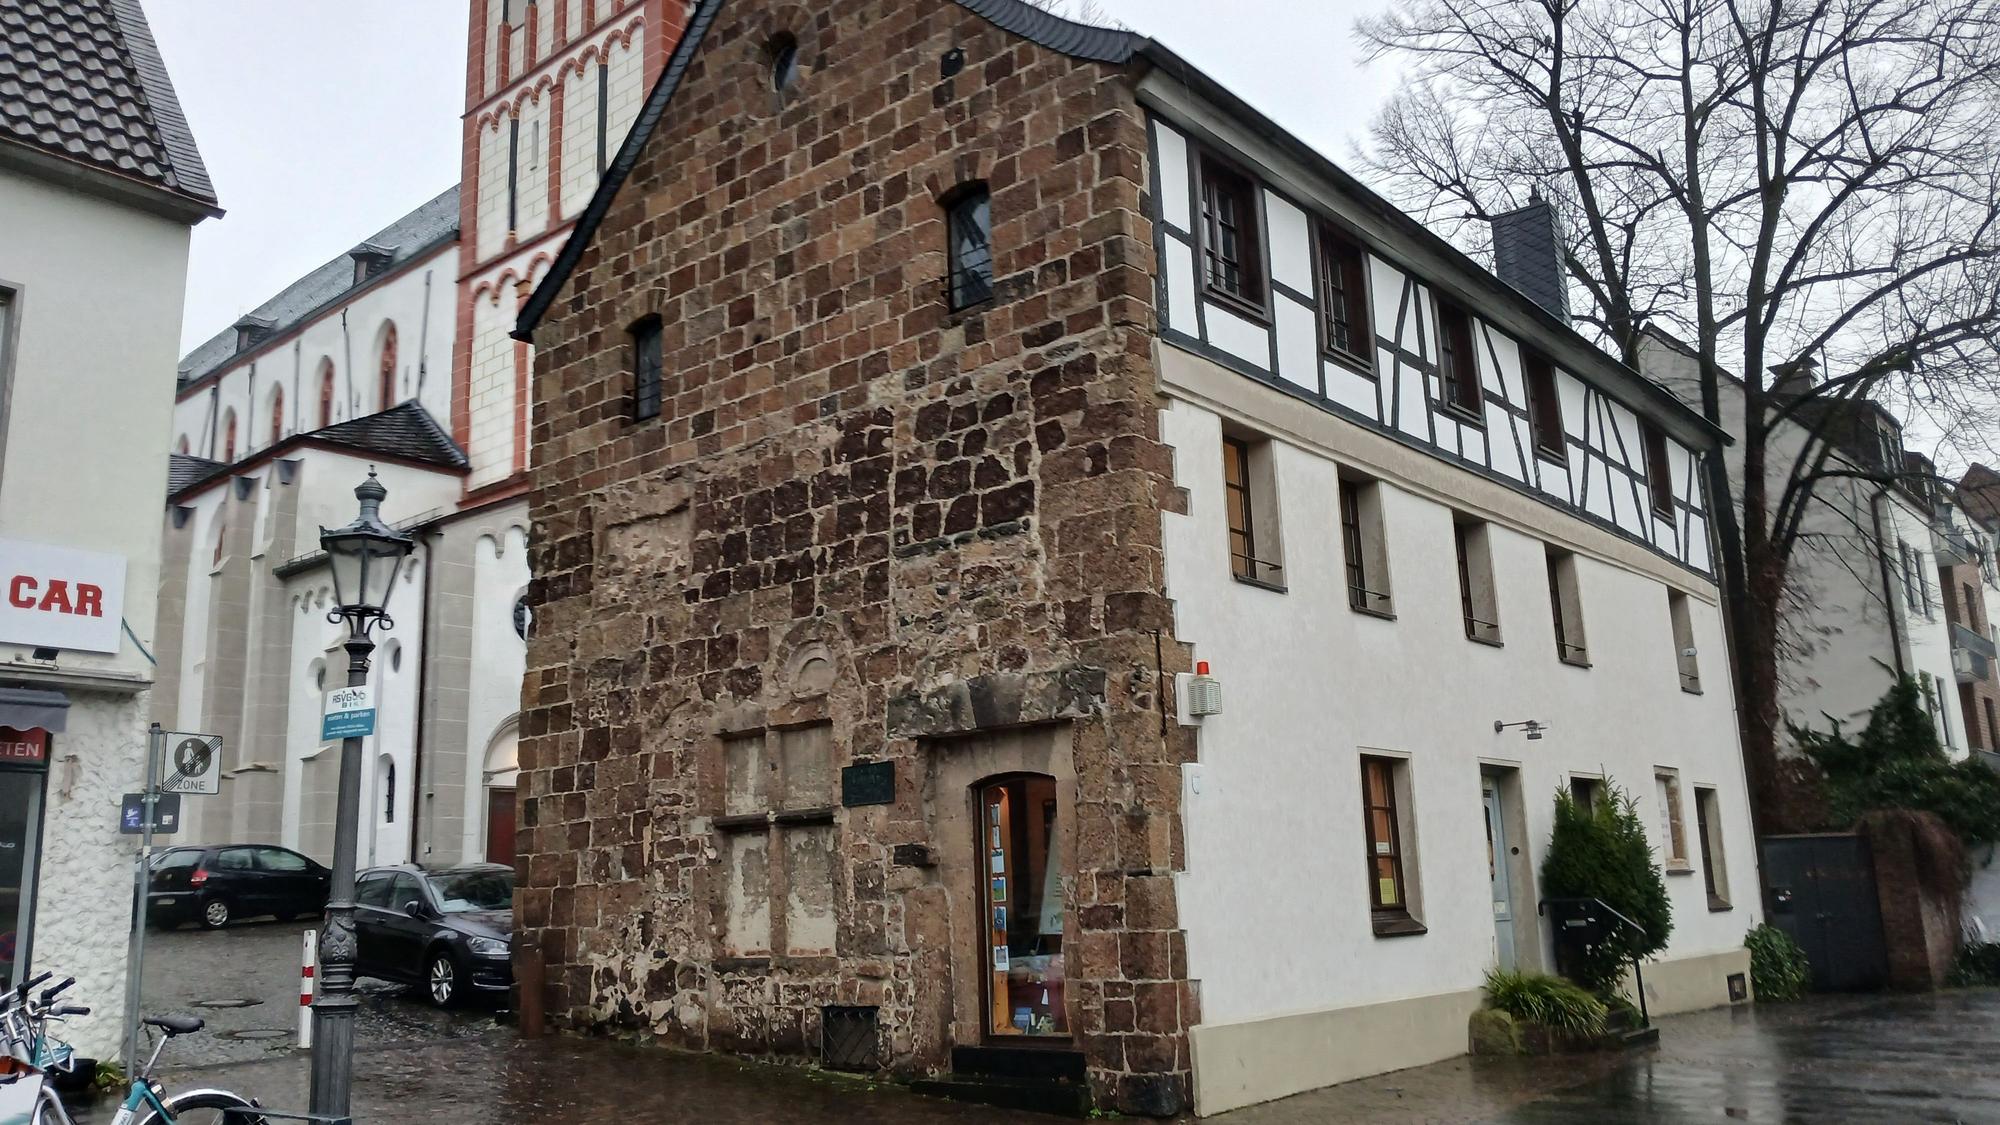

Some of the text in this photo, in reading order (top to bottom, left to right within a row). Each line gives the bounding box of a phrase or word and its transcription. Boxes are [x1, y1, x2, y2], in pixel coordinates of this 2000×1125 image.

[9, 575, 103, 618] CAR
[0, 742, 40, 757] TEN
[177, 780, 206, 791] ZONE
